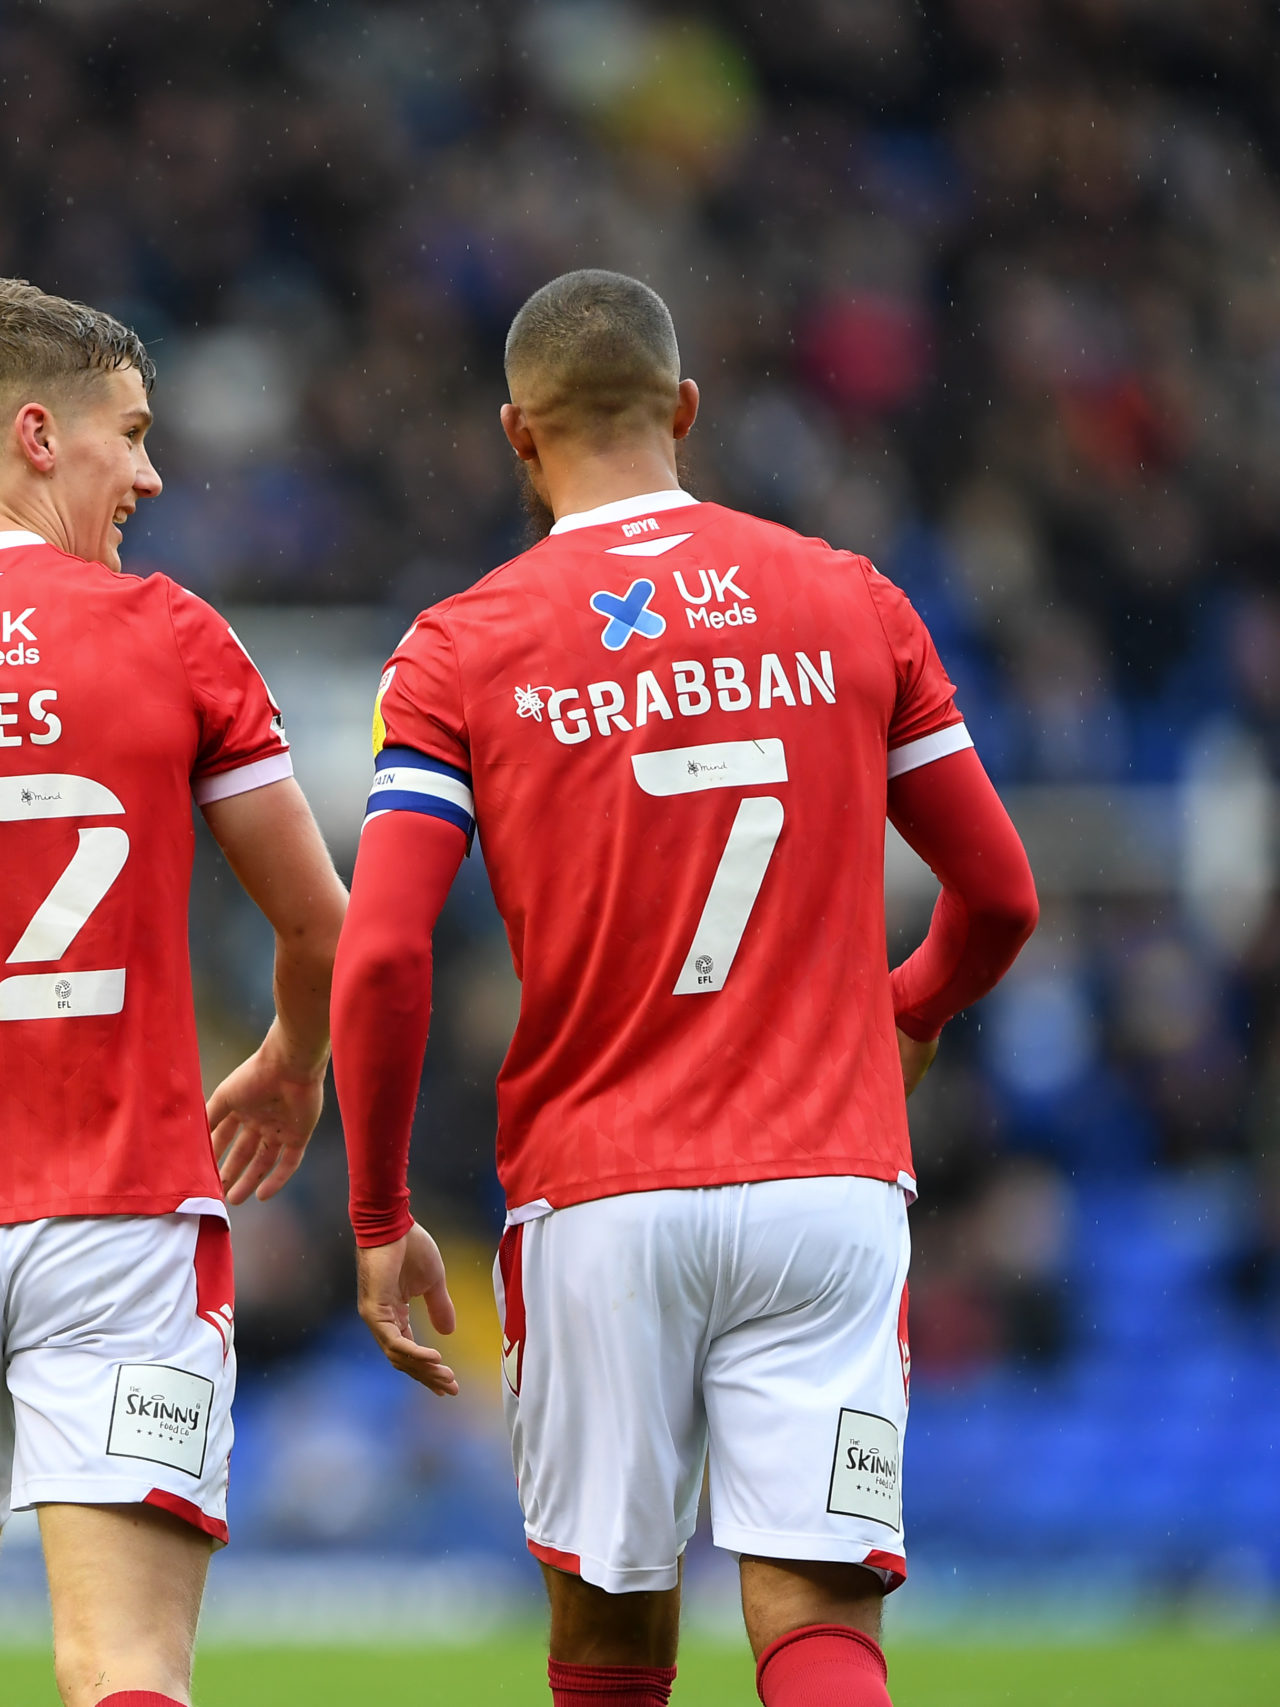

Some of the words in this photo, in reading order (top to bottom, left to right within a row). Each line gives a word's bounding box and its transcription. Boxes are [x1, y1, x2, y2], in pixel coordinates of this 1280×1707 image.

[621, 518, 660, 538] COYR
[672, 565, 751, 605] UK
[685, 602, 757, 629] Meds
[547, 650, 837, 744] GRABBAN
[630, 737, 788, 996] 7
[697, 975, 713, 984] EFL
[57, 1000, 72, 1009] EFL
